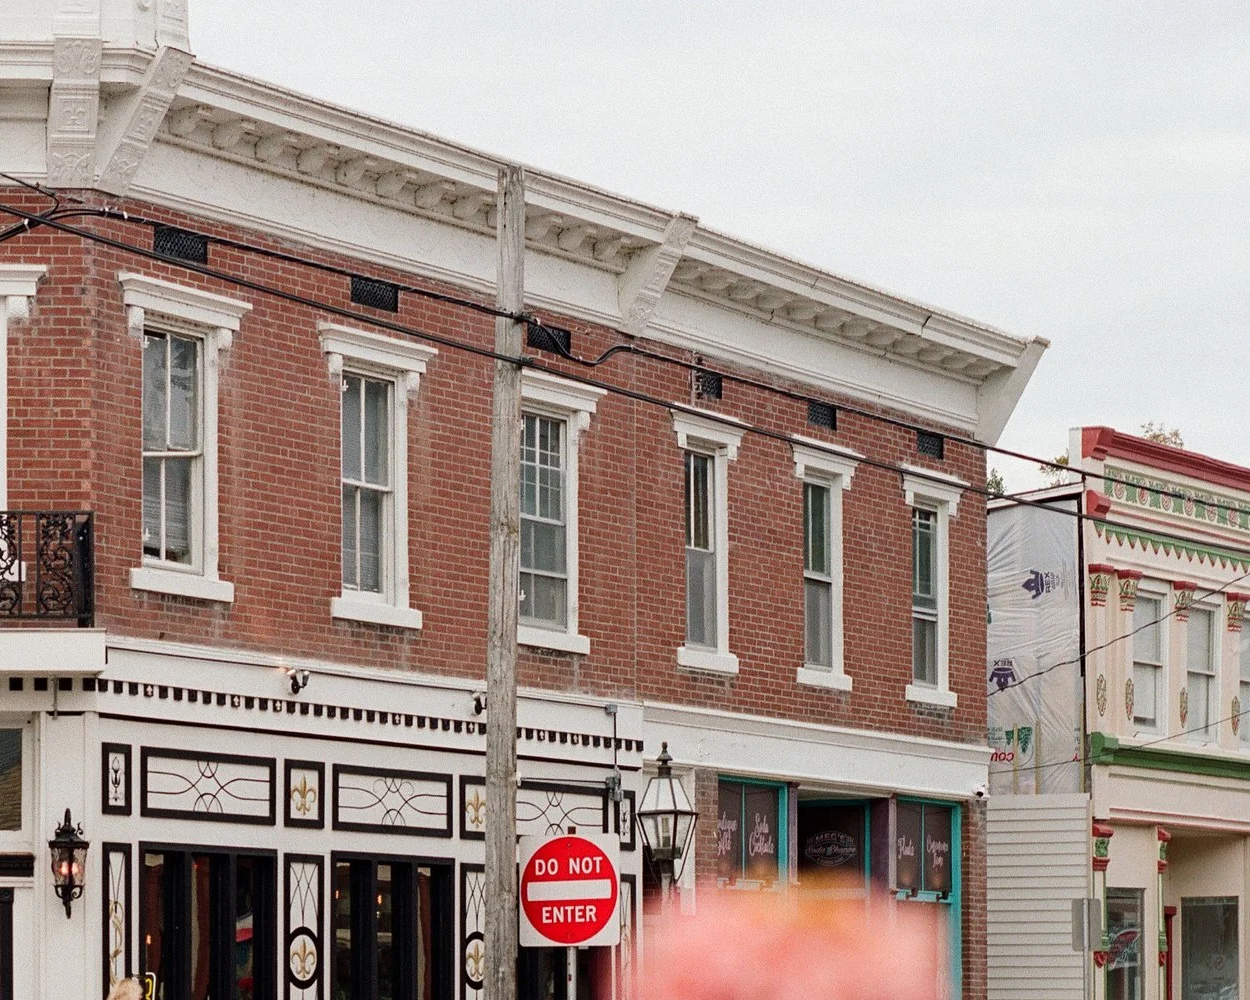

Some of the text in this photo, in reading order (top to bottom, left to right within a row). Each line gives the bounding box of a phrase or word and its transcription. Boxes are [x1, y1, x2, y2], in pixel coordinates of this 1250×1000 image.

[993, 659, 1013, 667] REX
[535, 856, 603, 876] DO NOT
[542, 905, 597, 924] ENTER
